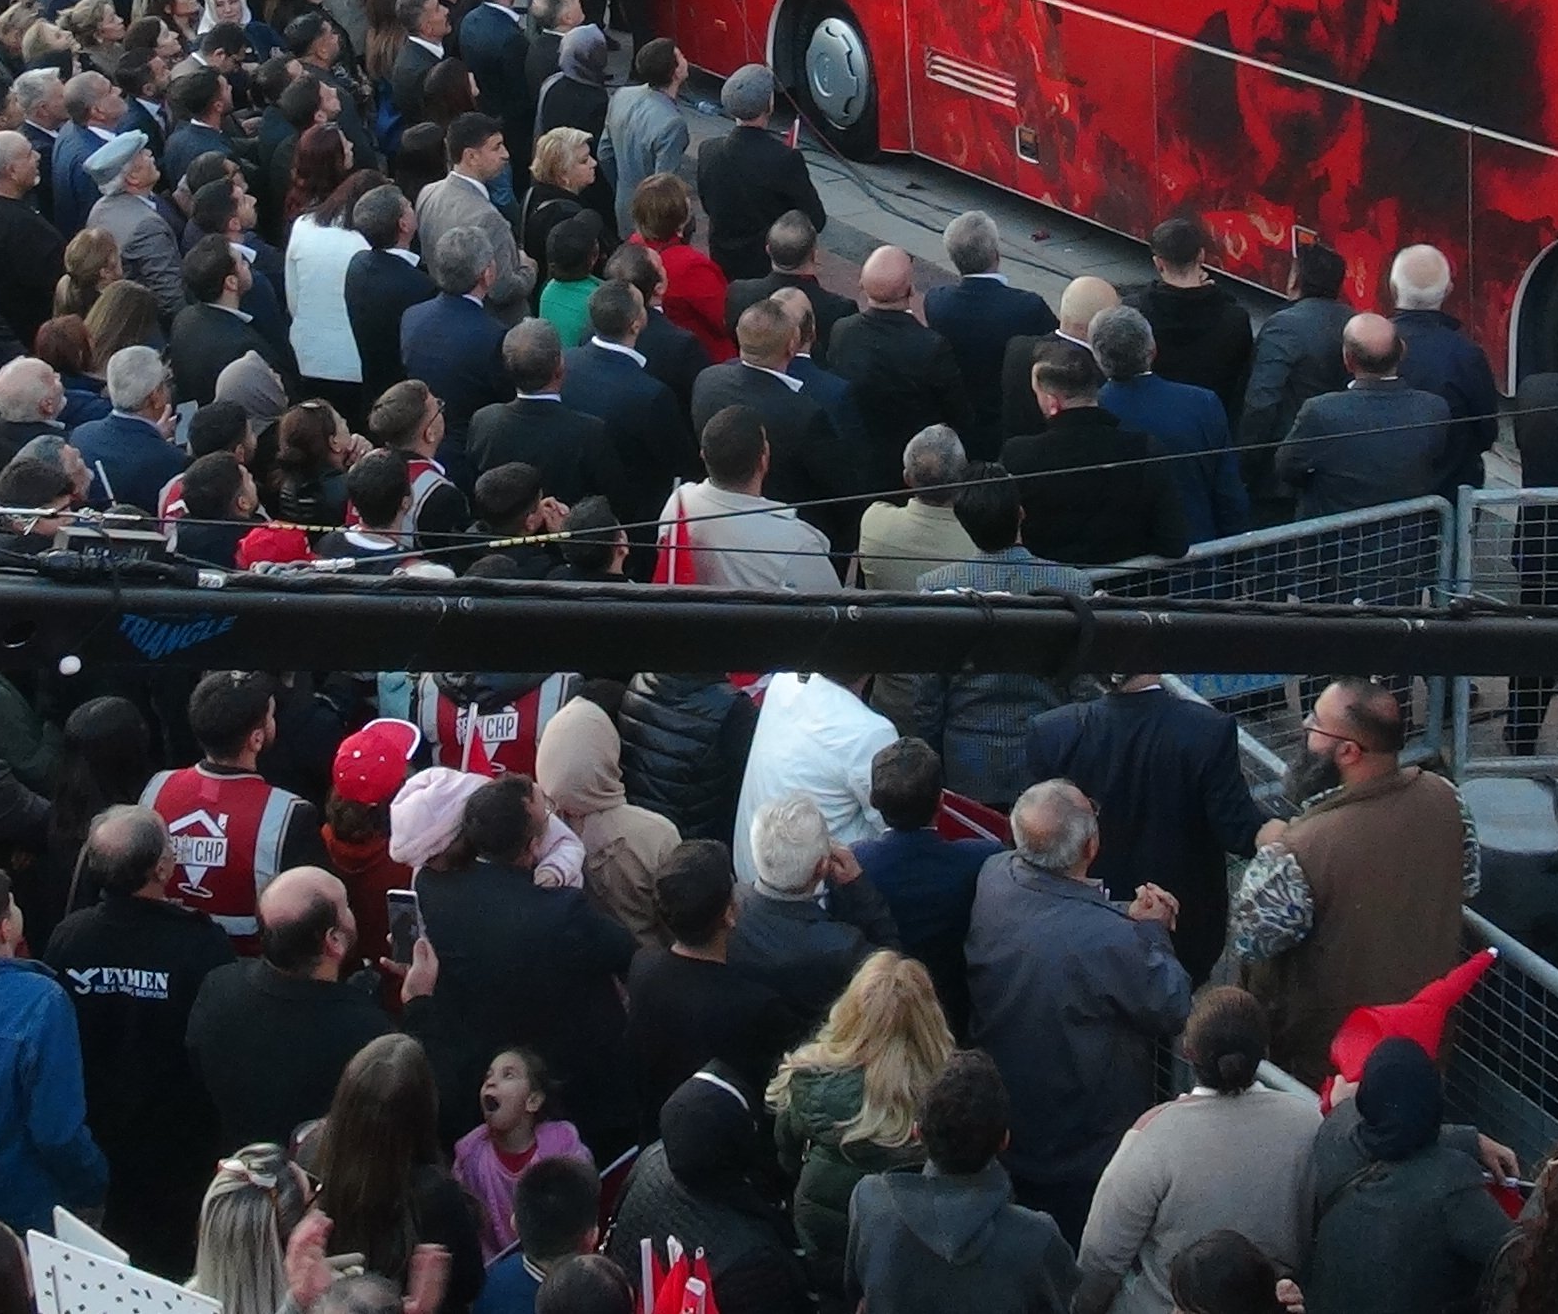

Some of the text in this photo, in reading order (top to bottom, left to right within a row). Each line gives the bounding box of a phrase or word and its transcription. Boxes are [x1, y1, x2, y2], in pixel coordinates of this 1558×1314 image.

[118, 613, 239, 660] TRIANGLE
[486, 716, 515, 739] CHP
[195, 840, 224, 863] CHP
